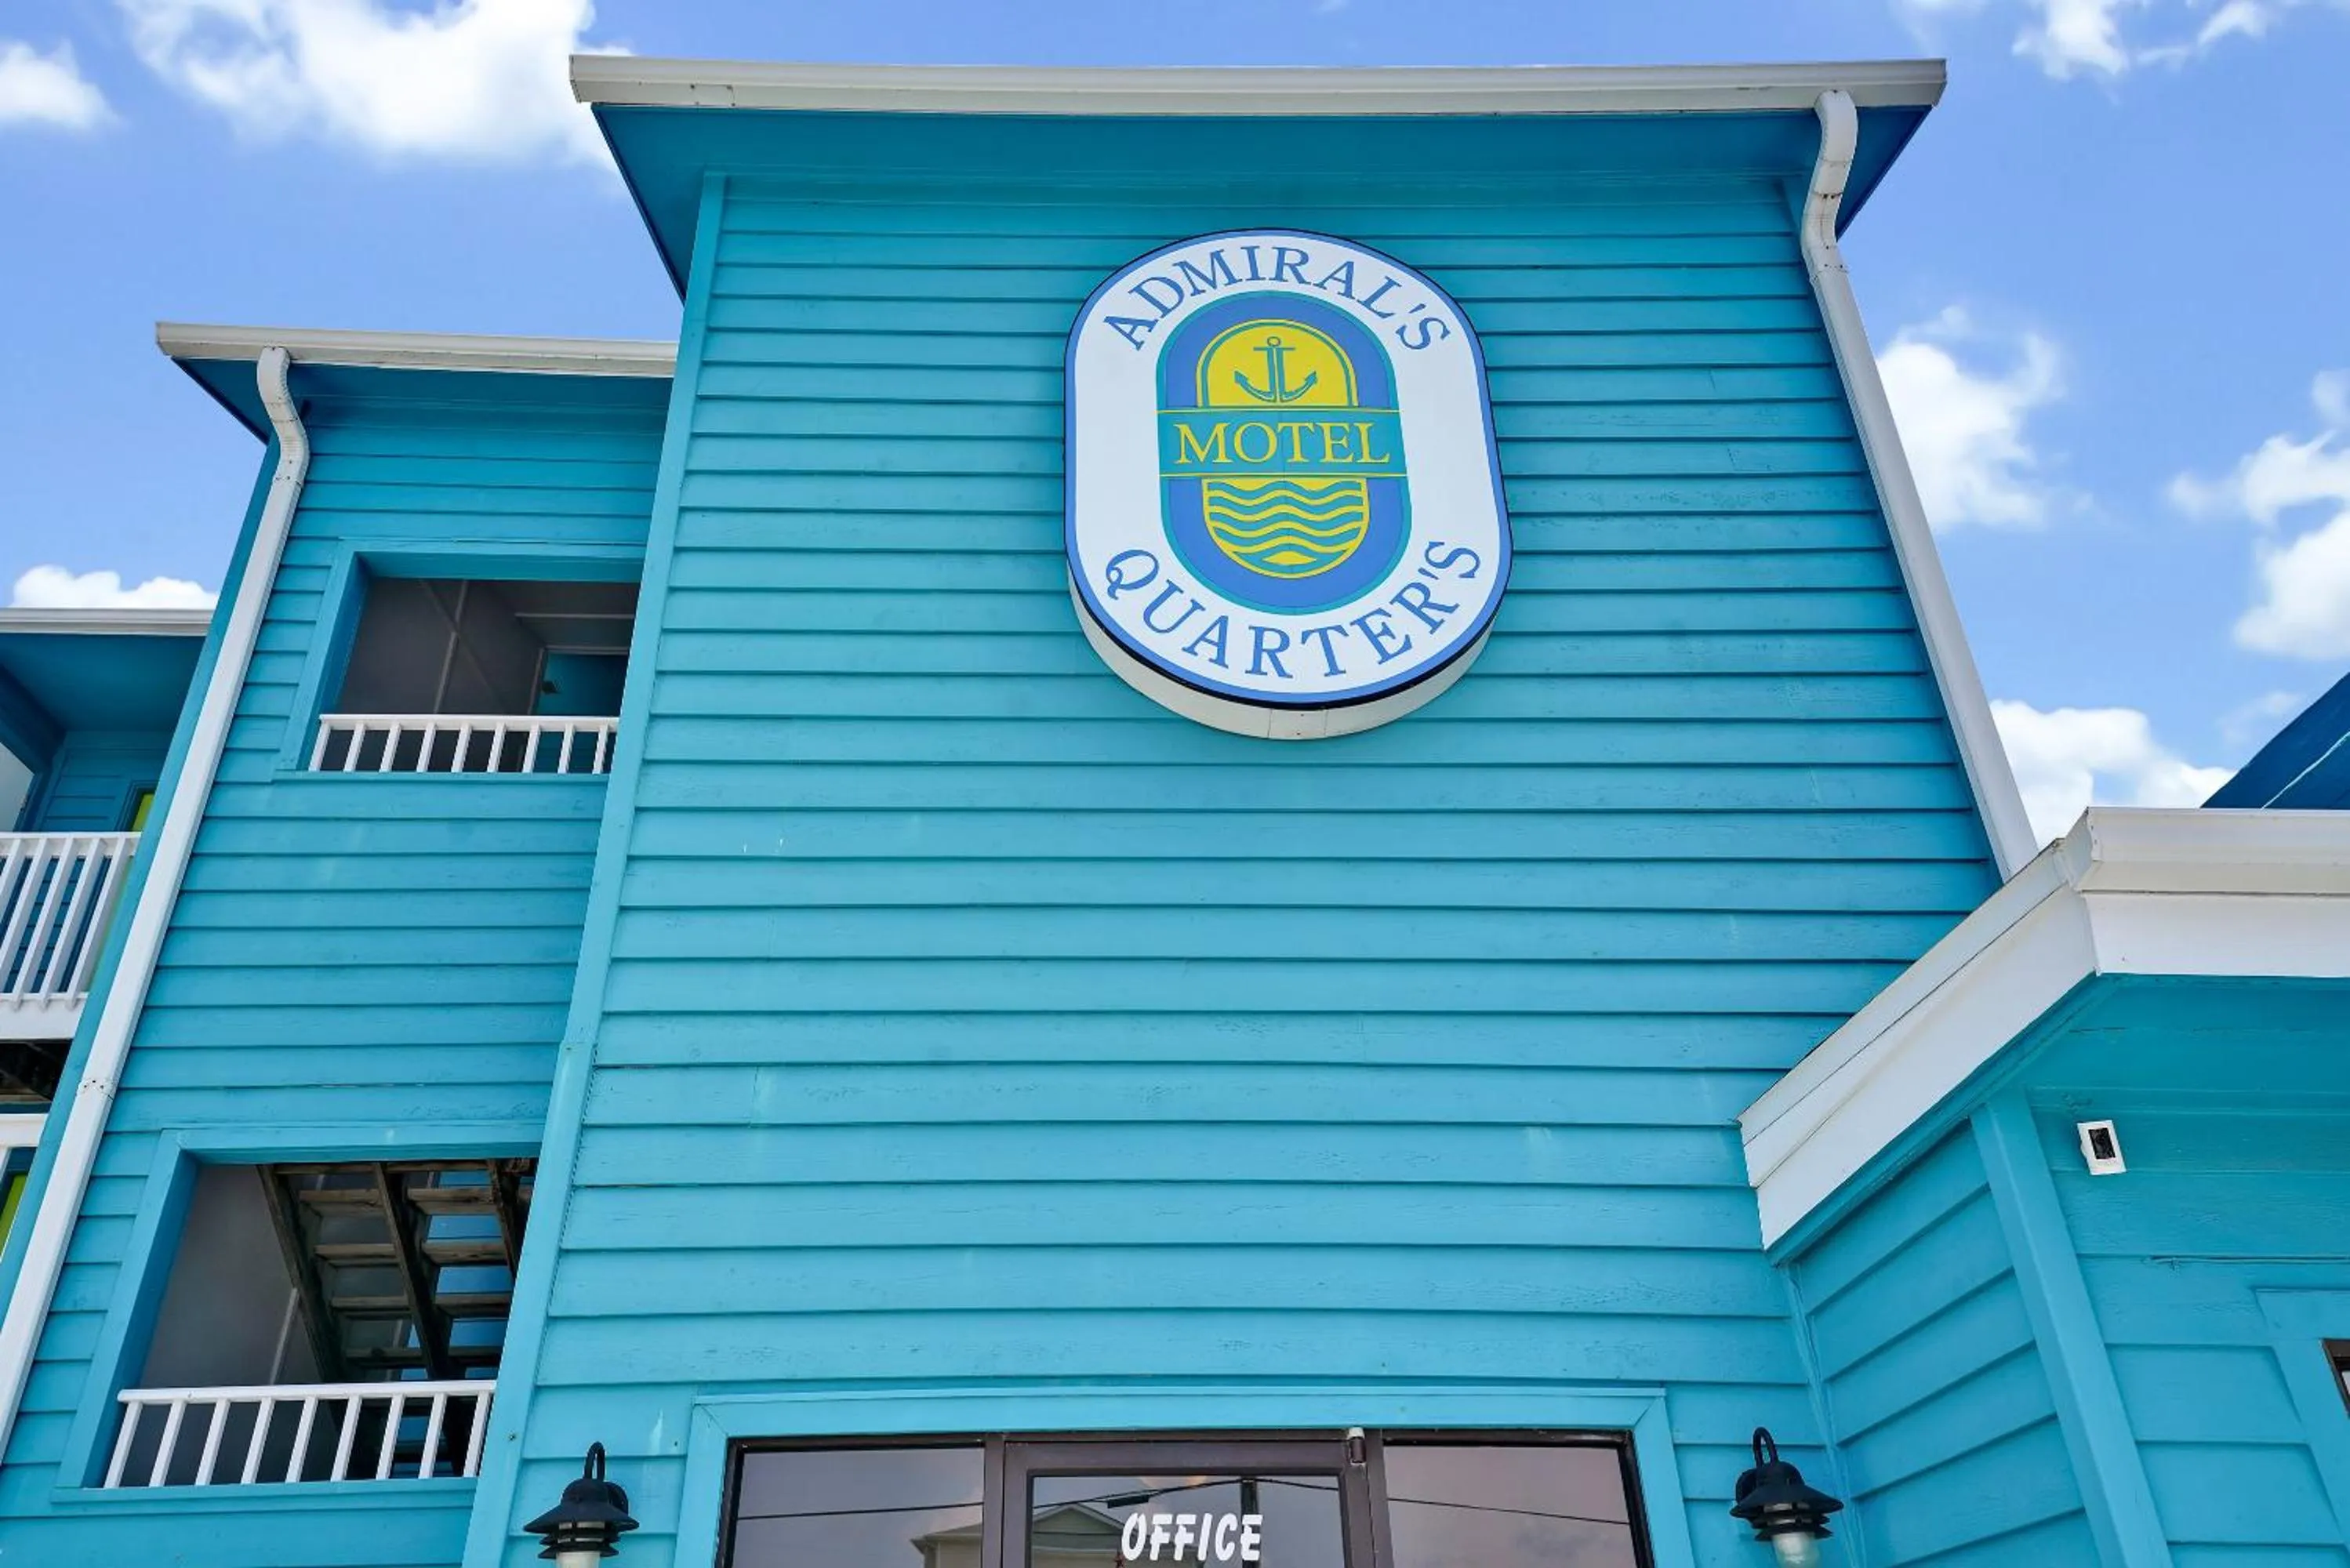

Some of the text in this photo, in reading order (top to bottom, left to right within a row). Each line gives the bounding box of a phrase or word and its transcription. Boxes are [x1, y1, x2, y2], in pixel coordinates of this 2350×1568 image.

[1103, 246, 1451, 350] ADMIRAL'S
[1175, 422, 1390, 464] MOTEL
[1105, 541, 1481, 679] QUARTER'S
[1121, 1512, 1263, 1561] OFFICE
